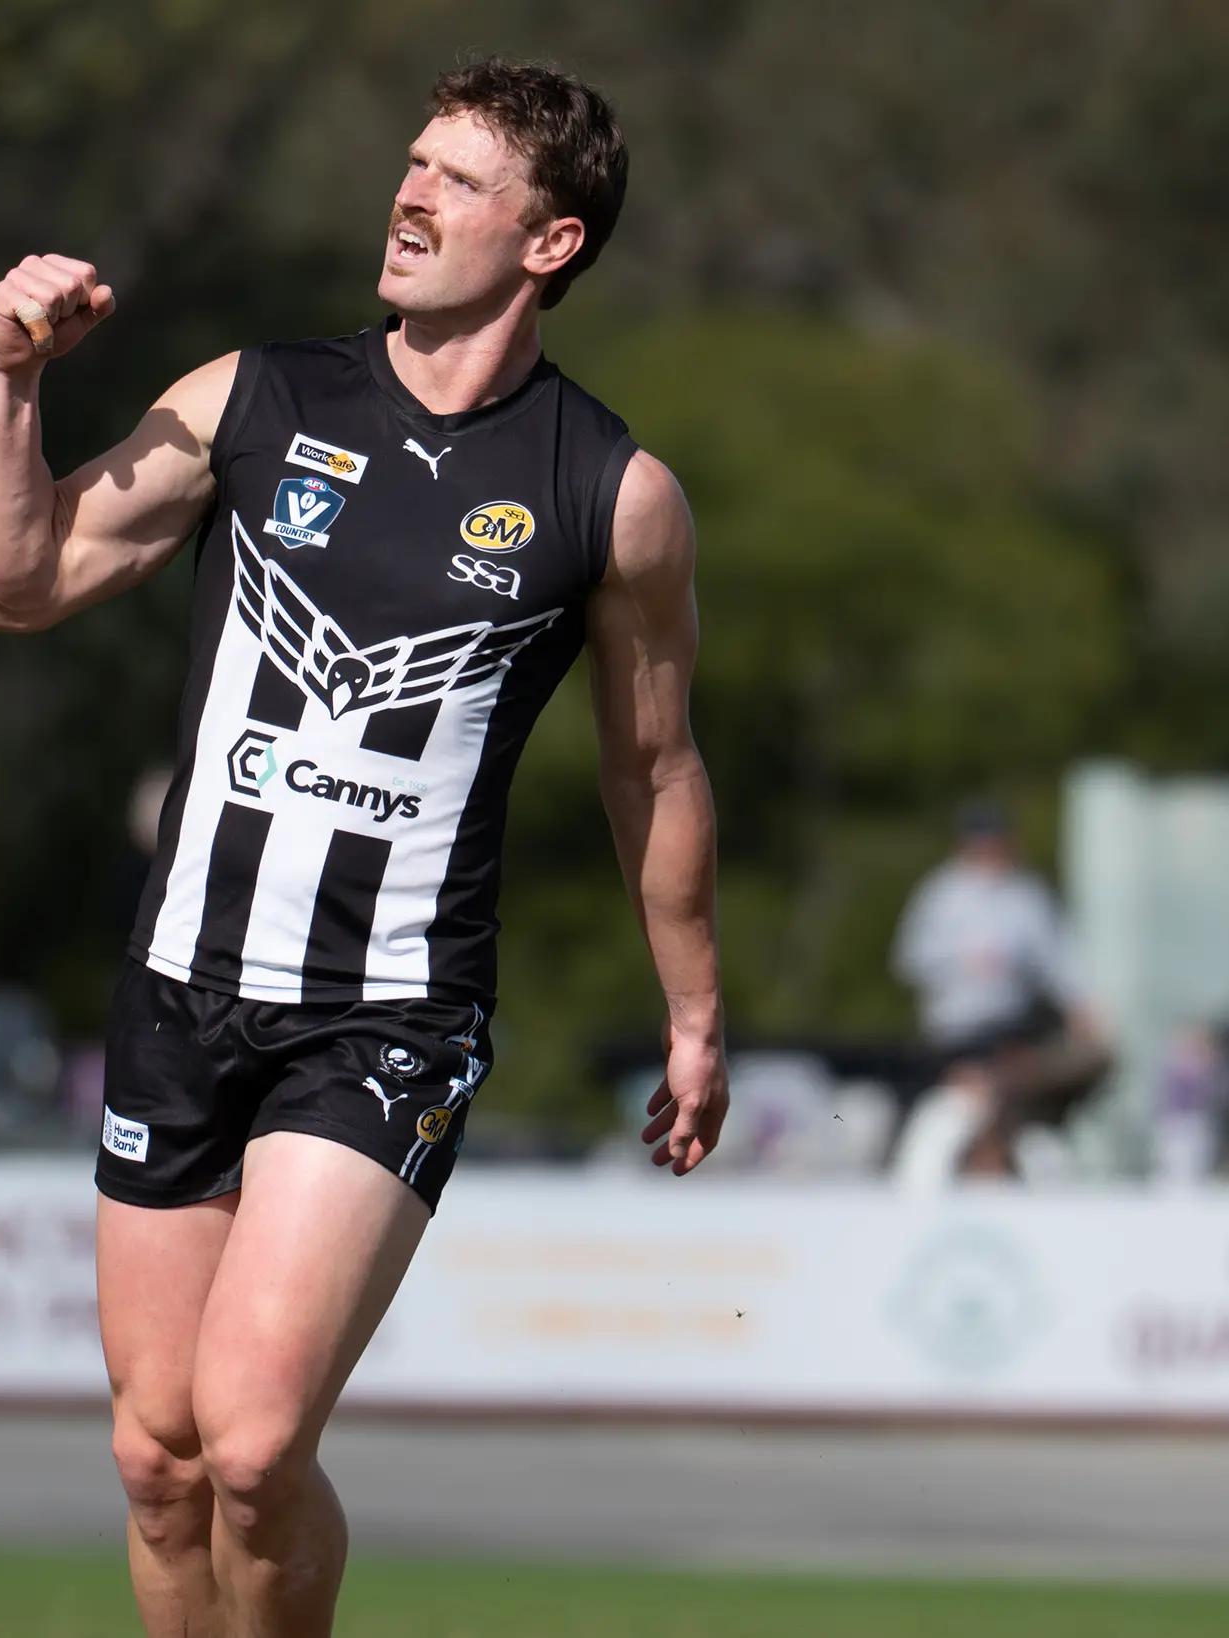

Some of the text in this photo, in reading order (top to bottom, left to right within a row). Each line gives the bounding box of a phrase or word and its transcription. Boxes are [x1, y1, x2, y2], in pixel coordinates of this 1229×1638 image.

[301, 445, 352, 470] WorkSafe
[303, 479, 327, 492] AFL
[504, 508, 526, 521] ssa
[275, 524, 316, 541] COUNTRY
[447, 554, 521, 600] ssa
[285, 759, 422, 823] Cannys
[114, 1122, 143, 1141] Hume
[113, 1136, 138, 1154] Bank
